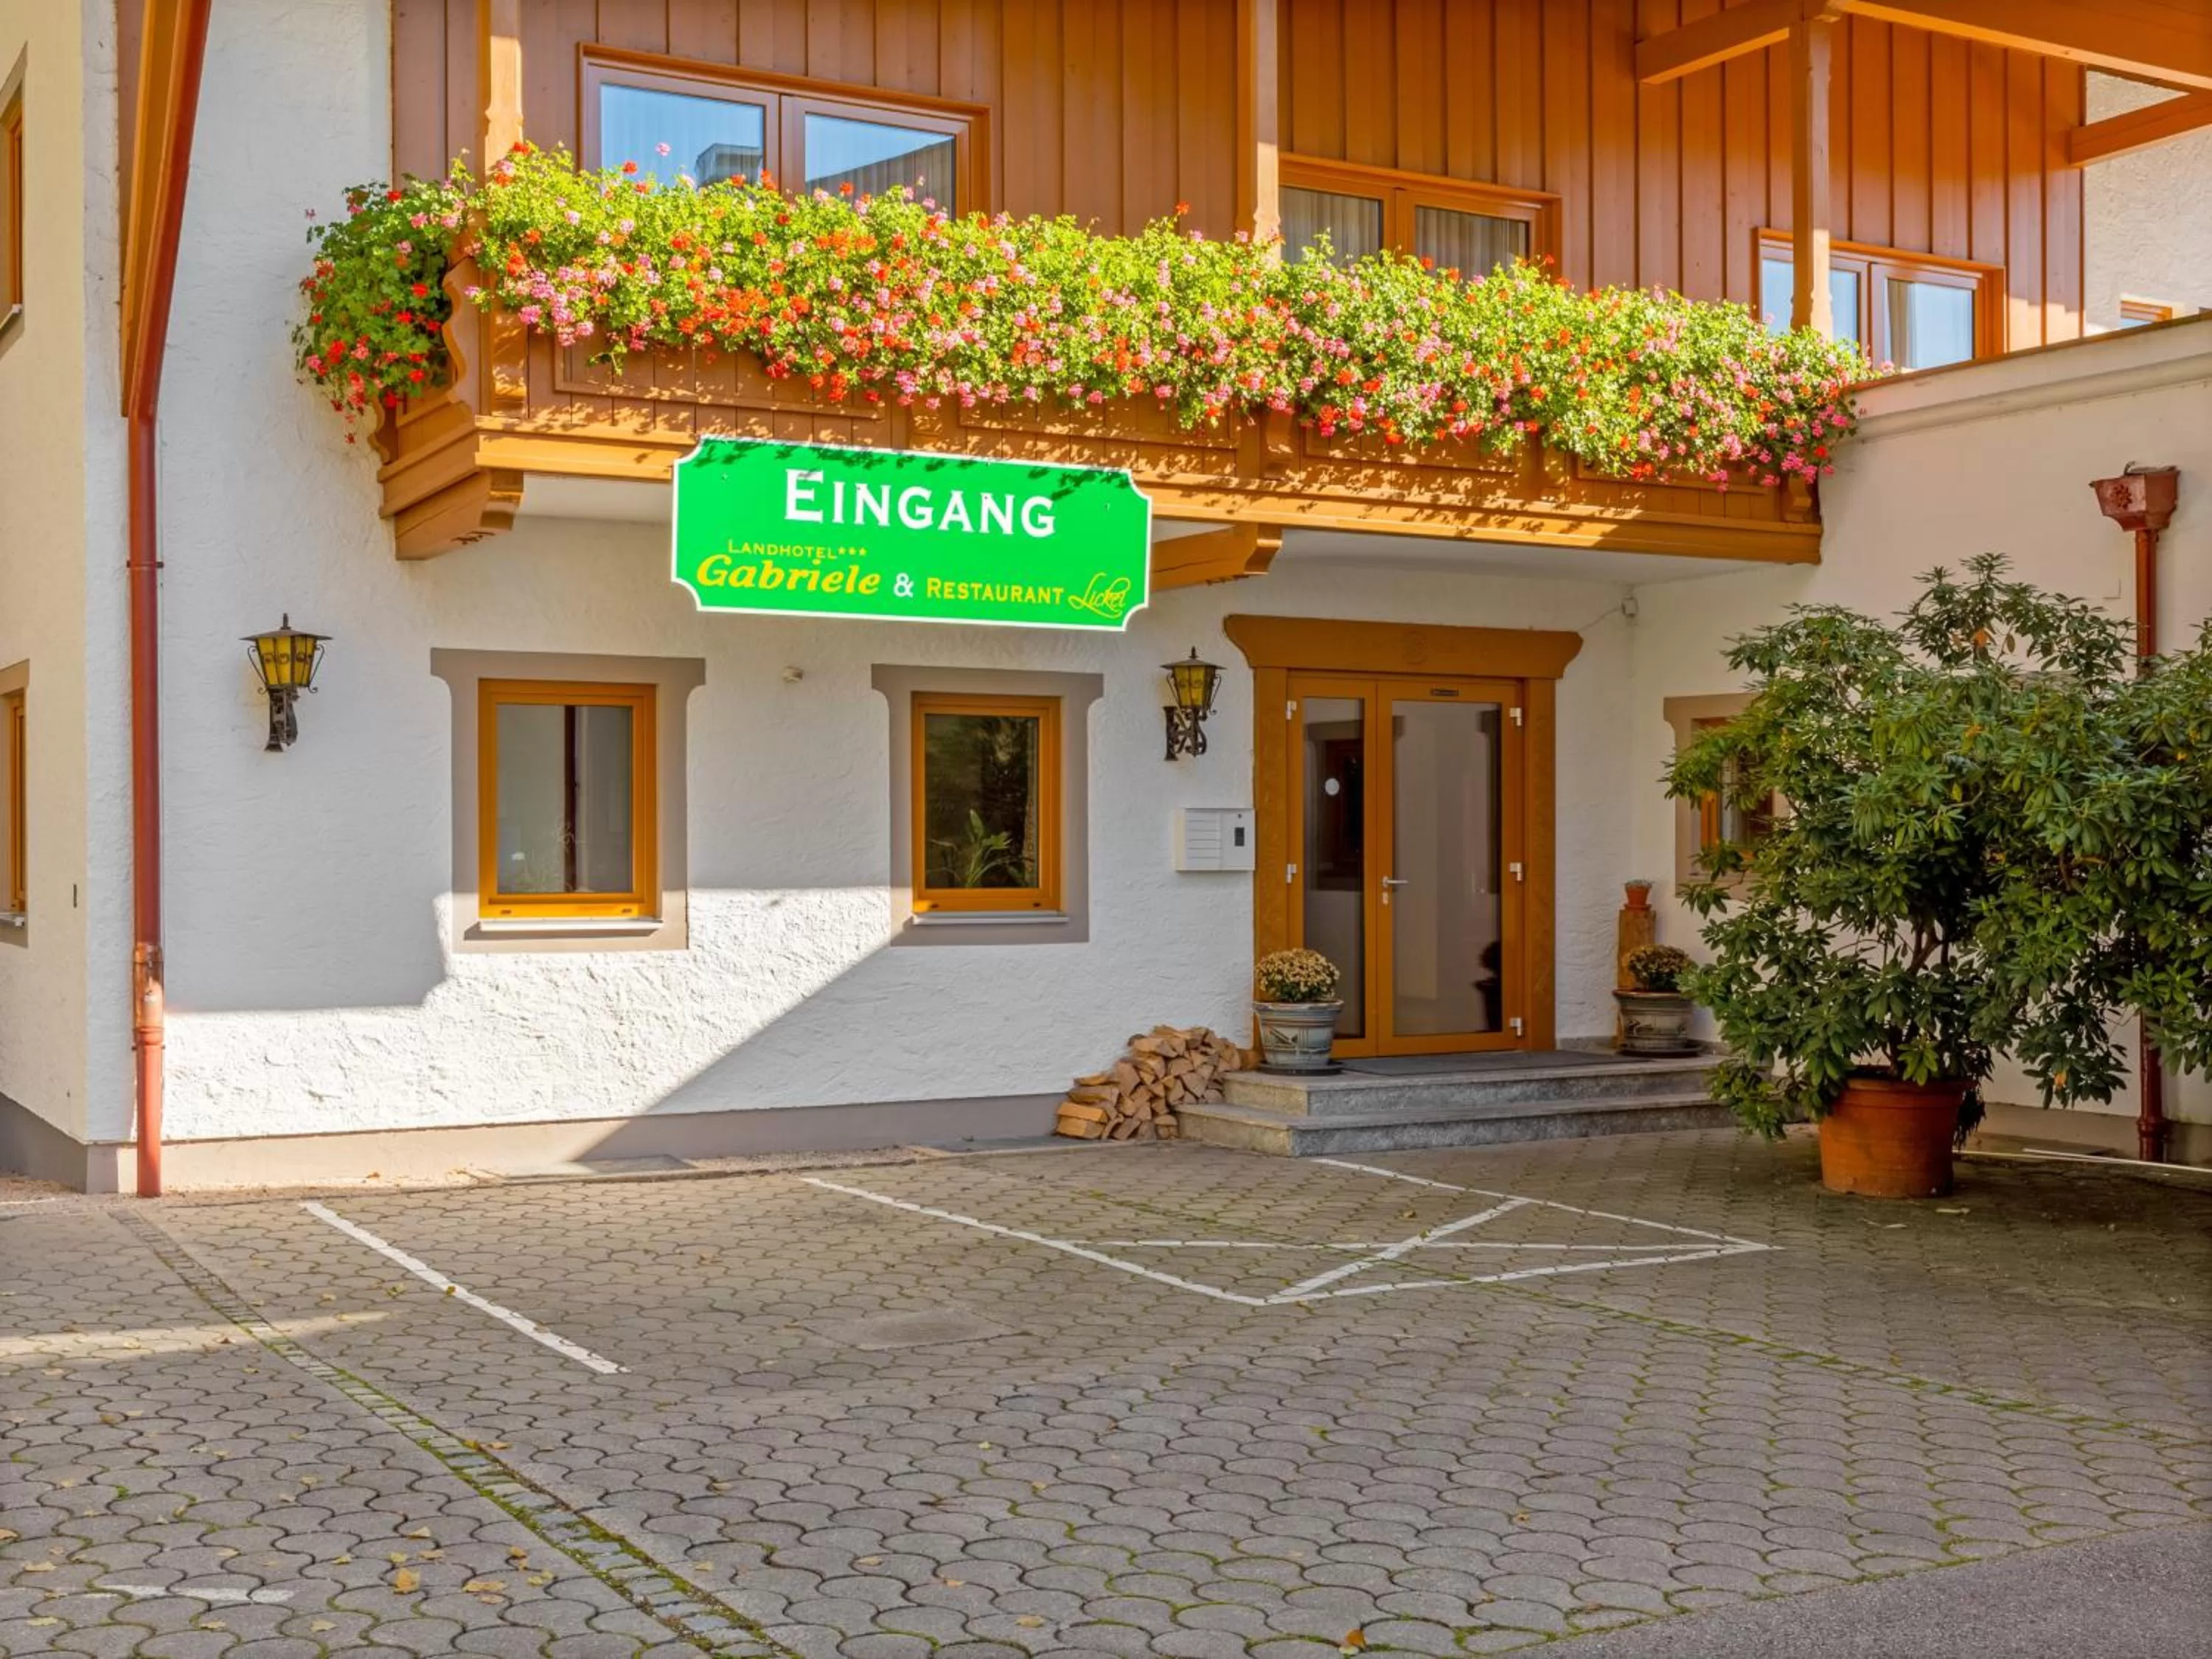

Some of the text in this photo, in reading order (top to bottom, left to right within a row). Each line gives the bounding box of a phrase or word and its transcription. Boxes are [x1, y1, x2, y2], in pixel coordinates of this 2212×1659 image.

[785, 468, 1056, 538] EINGANG
[727, 539, 838, 560] LANDHOTEL
[697, 554, 882, 595] Gabriele
[893, 572, 914, 598] &
[926, 577, 1064, 605] RESTAURANT
